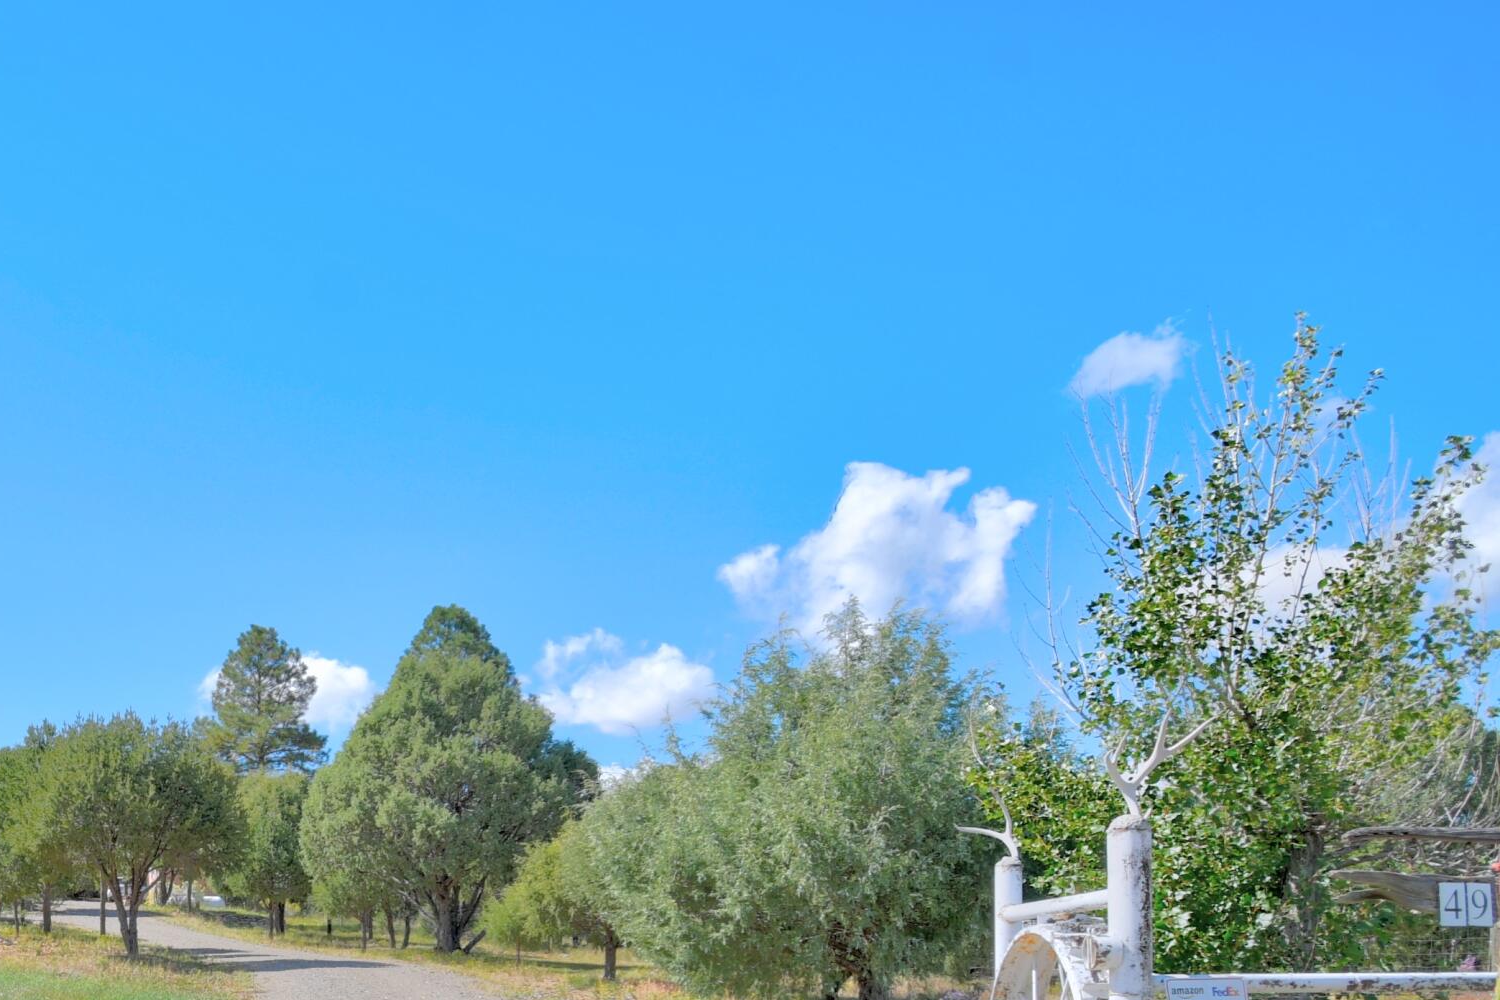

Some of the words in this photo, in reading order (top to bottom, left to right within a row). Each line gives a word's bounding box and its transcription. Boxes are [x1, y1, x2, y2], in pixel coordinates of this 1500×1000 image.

[1444, 888, 1488, 920] 49
[1171, 987, 1204, 995] amazon
[1211, 986, 1239, 997] FedEx
